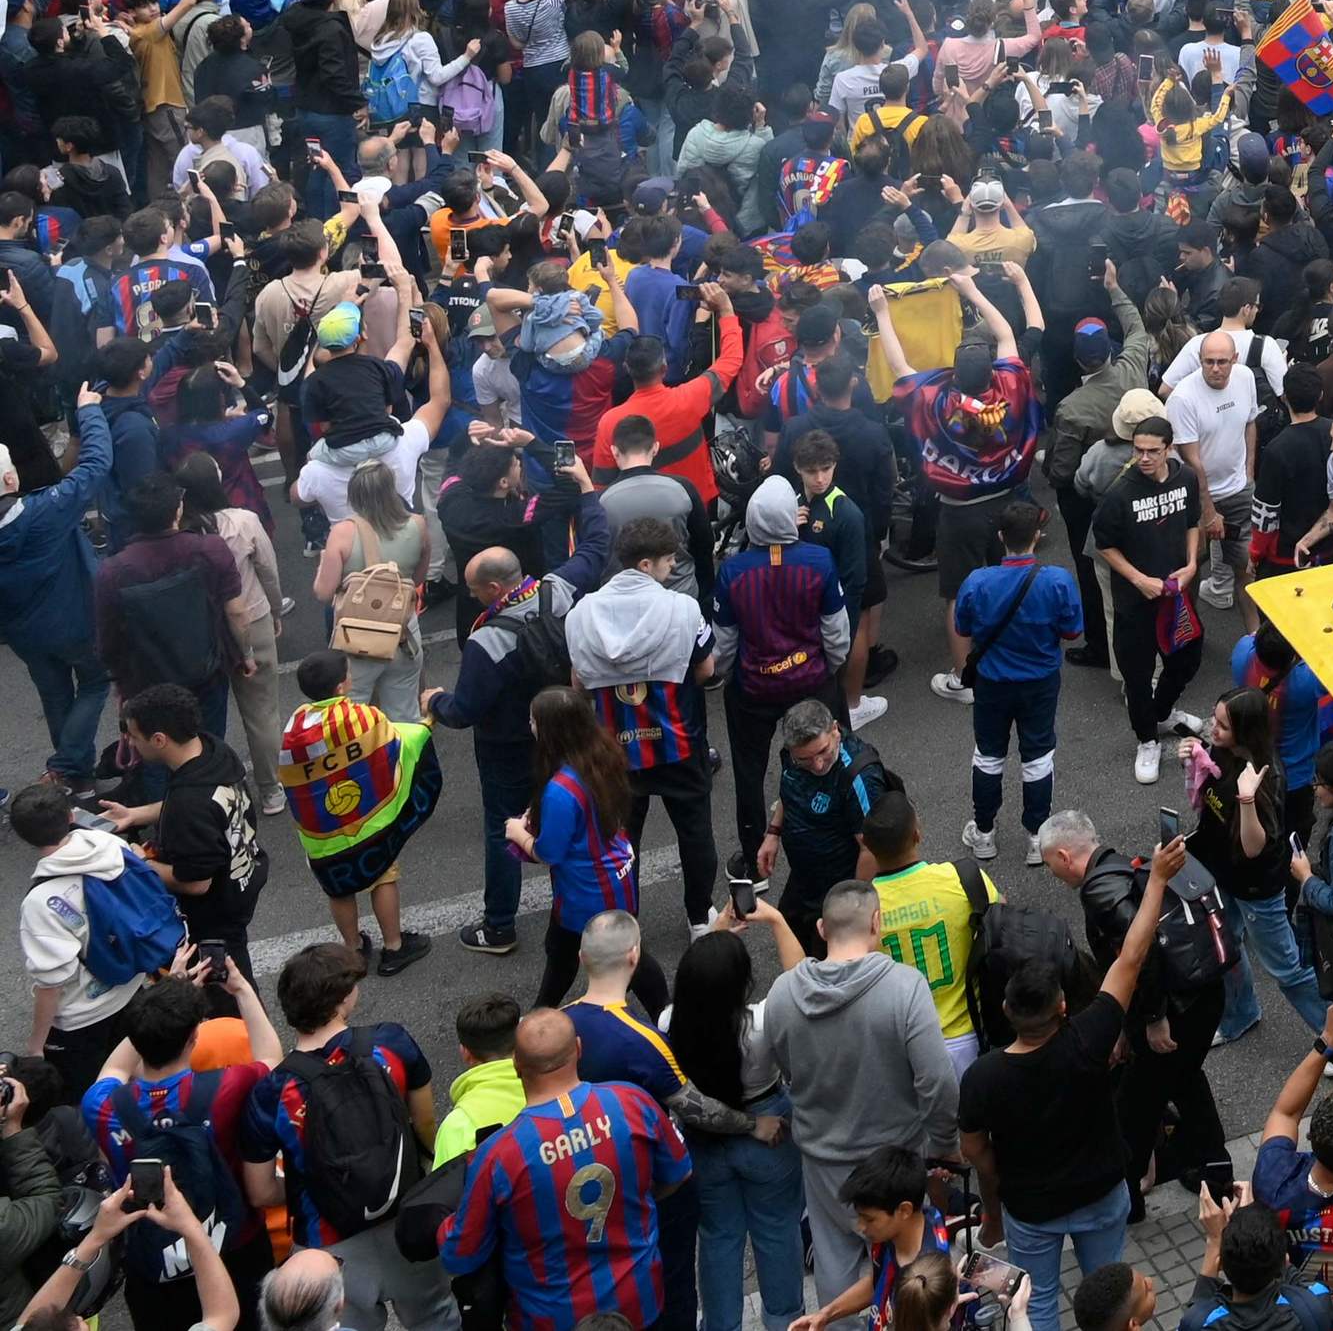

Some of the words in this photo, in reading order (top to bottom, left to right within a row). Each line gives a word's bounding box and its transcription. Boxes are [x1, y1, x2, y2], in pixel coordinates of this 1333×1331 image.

[863, 85, 879, 96] PED
[132, 279, 168, 297] PEDR
[1132, 486, 1188, 513] BARCELONA
[1136, 507, 1160, 523] JUST
[1160, 504, 1175, 518] DO
[1176, 498, 1187, 512] IT.
[760, 655, 793, 675] unicef
[302, 741, 364, 780] FCB
[881, 900, 930, 928] HIAGO
[883, 918, 954, 991] 10
[538, 1115, 613, 1166] GARLY
[564, 1162, 617, 1243] 9
